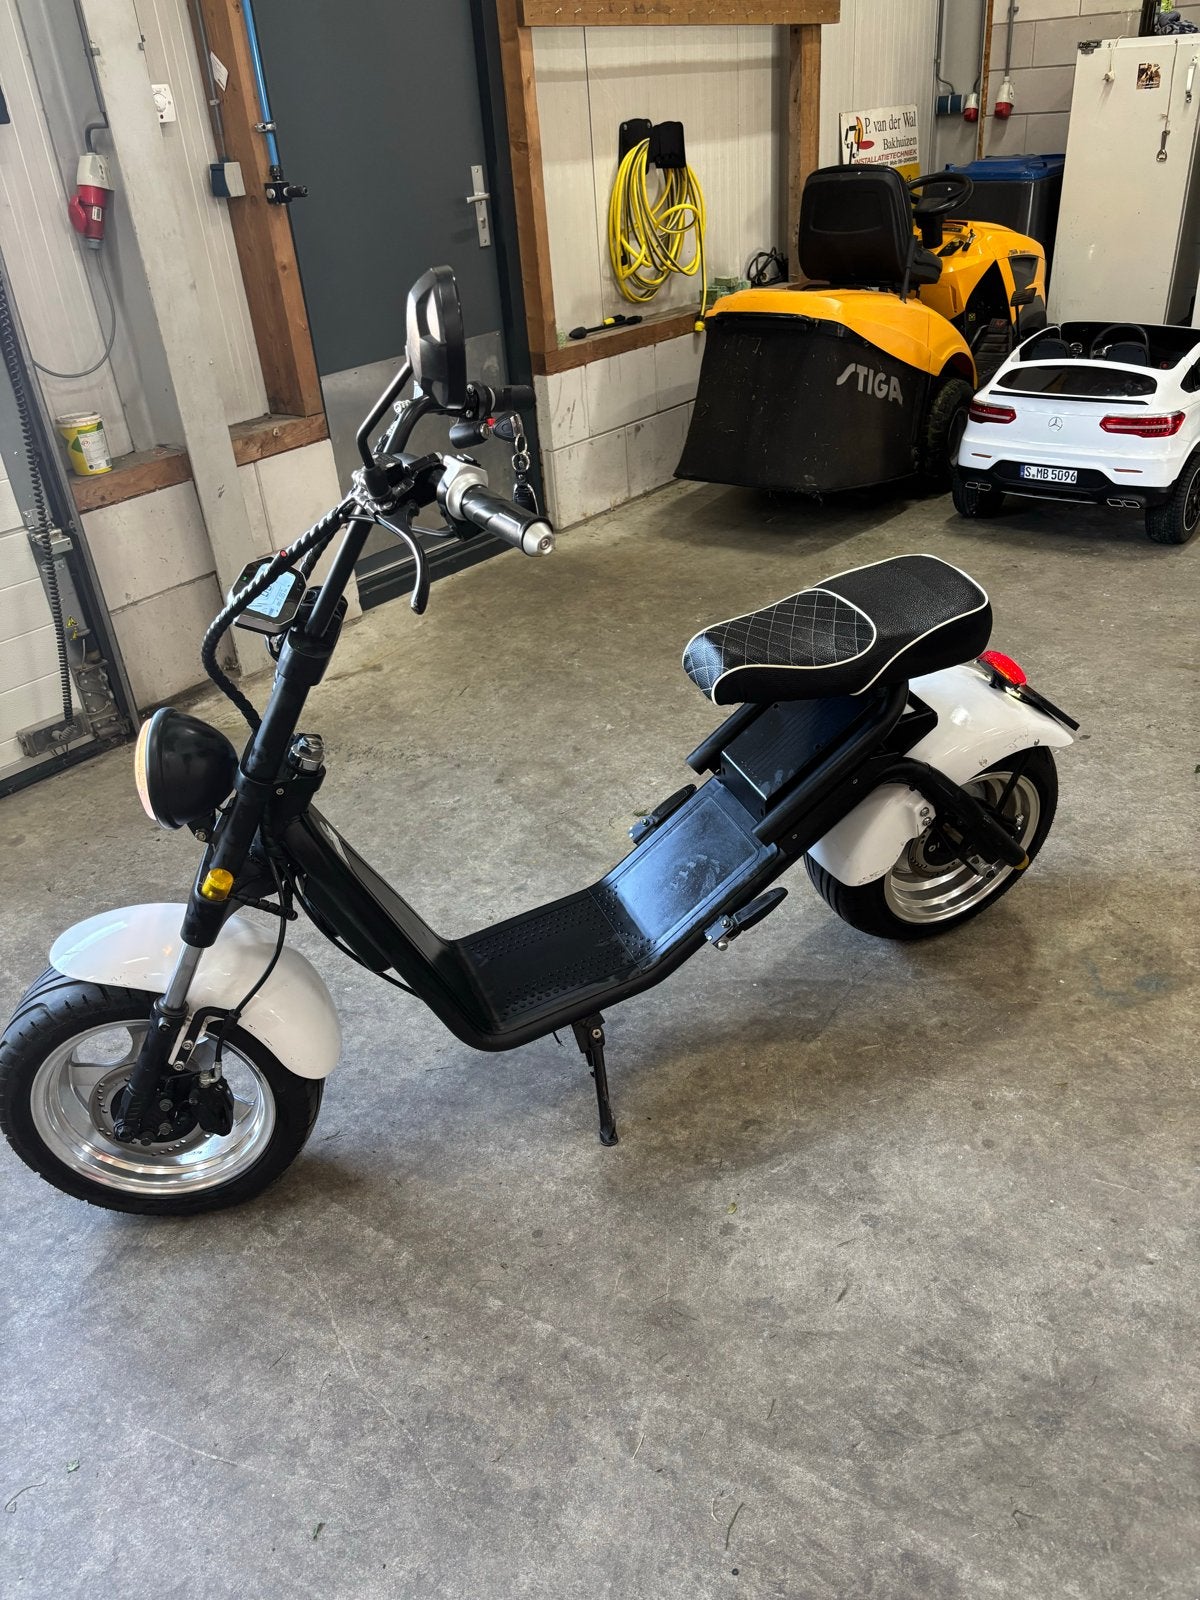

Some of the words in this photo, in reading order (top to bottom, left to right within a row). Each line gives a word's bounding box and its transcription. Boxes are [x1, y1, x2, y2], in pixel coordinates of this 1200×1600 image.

[864, 117, 872, 134] P.
[873, 120, 887, 133] van
[889, 113, 901, 130] der
[902, 111, 917, 128] Wal
[883, 136, 917, 151] Bakhuizen
[836, 363, 903, 405] STIGA
[1051, 470, 1077, 482] 5096
